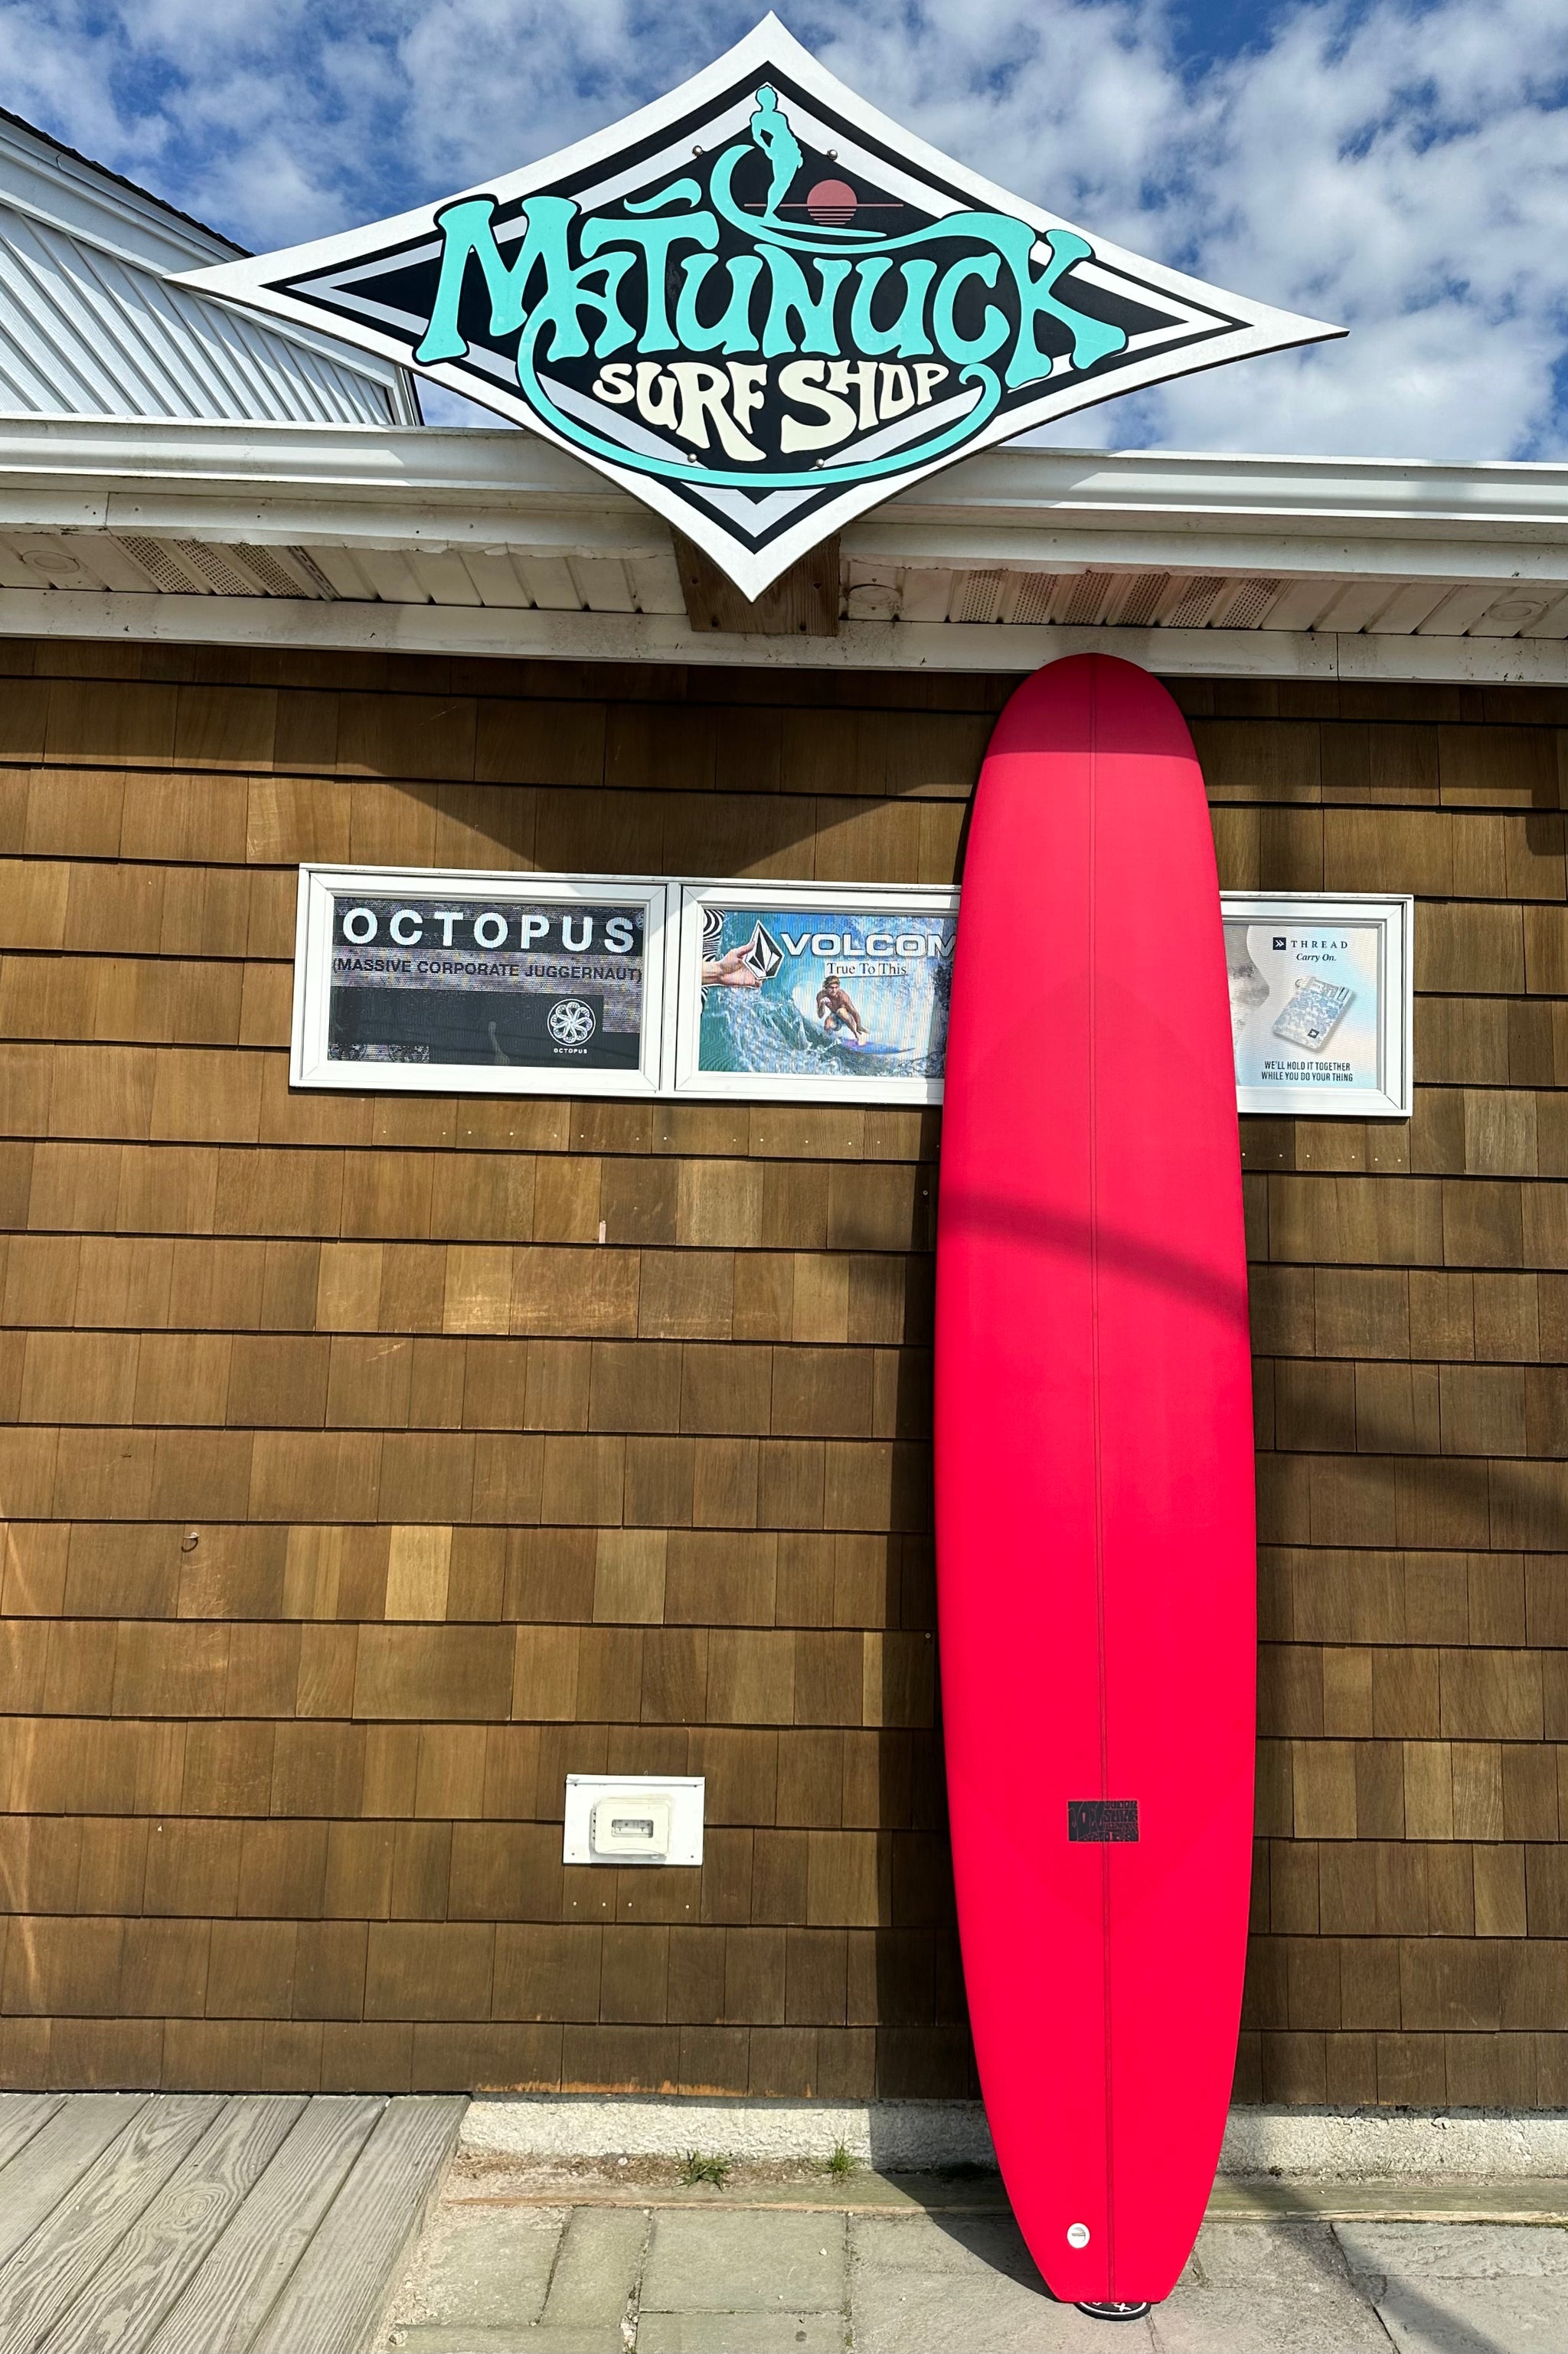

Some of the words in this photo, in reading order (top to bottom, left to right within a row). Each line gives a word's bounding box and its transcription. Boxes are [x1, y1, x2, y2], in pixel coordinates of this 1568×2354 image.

[592, 361, 768, 462] SURF
[779, 359, 950, 453] SHOP
[342, 907, 634, 953] OCTOPUS
[779, 932, 957, 958] VOLCOM
[1290, 940, 1348, 949] THREAD
[1296, 953, 1320, 963] Carry
[332, 958, 412, 973] (MASSIVE
[417, 961, 520, 976] CORPORATE
[524, 965, 642, 983] JUGGERNAUT)
[826, 962, 856, 975] True
[858, 963, 876, 975] To
[878, 963, 907, 976] This
[1264, 1061, 1285, 1070] WE'LL
[1287, 1061, 1305, 1071] HOLD
[1307, 1061, 1315, 1071] IT
[1315, 1062, 1351, 1071] TOGETHER
[1261, 1071, 1284, 1081] WHILE
[1285, 1071, 1298, 1081] YOU
[1300, 1072, 1311, 1081] DO
[1312, 1072, 1331, 1081] YOUR
[1331, 1073, 1354, 1082] THING
